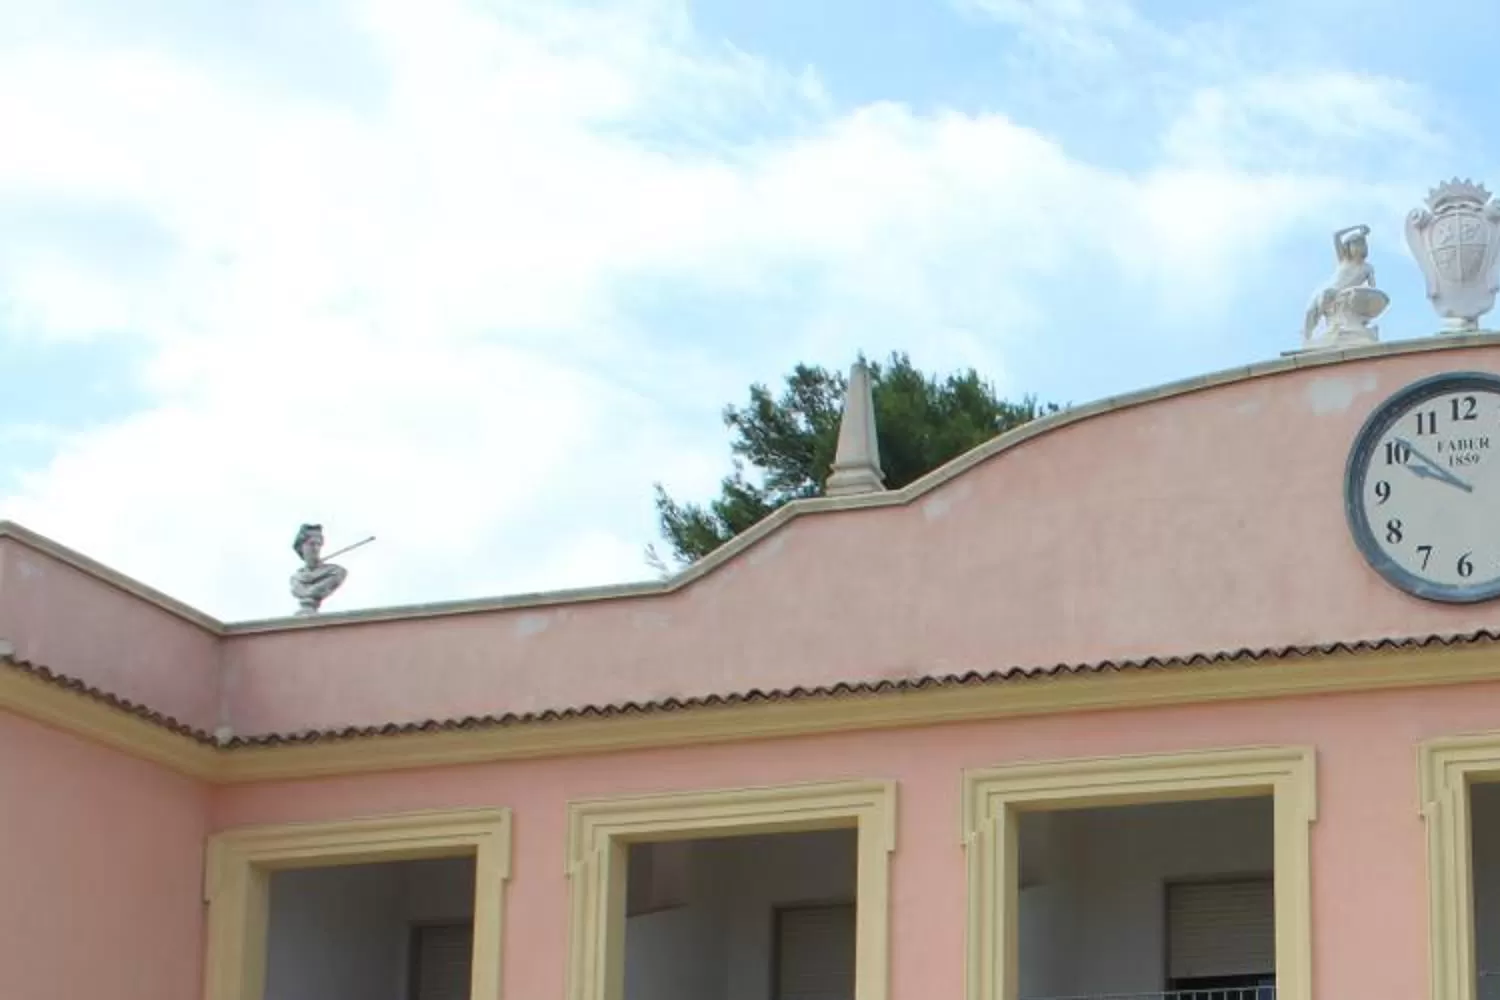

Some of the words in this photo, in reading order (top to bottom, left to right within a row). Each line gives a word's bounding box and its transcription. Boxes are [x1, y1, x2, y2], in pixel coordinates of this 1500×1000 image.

[1451, 396, 1477, 421] 12
[1415, 411, 1437, 435] 11
[1385, 442, 1410, 465] 10
[1437, 436, 1490, 453] FABER
[1375, 480, 1391, 504] 9
[1386, 519, 1403, 544] 8
[1416, 545, 1433, 571] 7
[1457, 552, 1473, 577] 6
